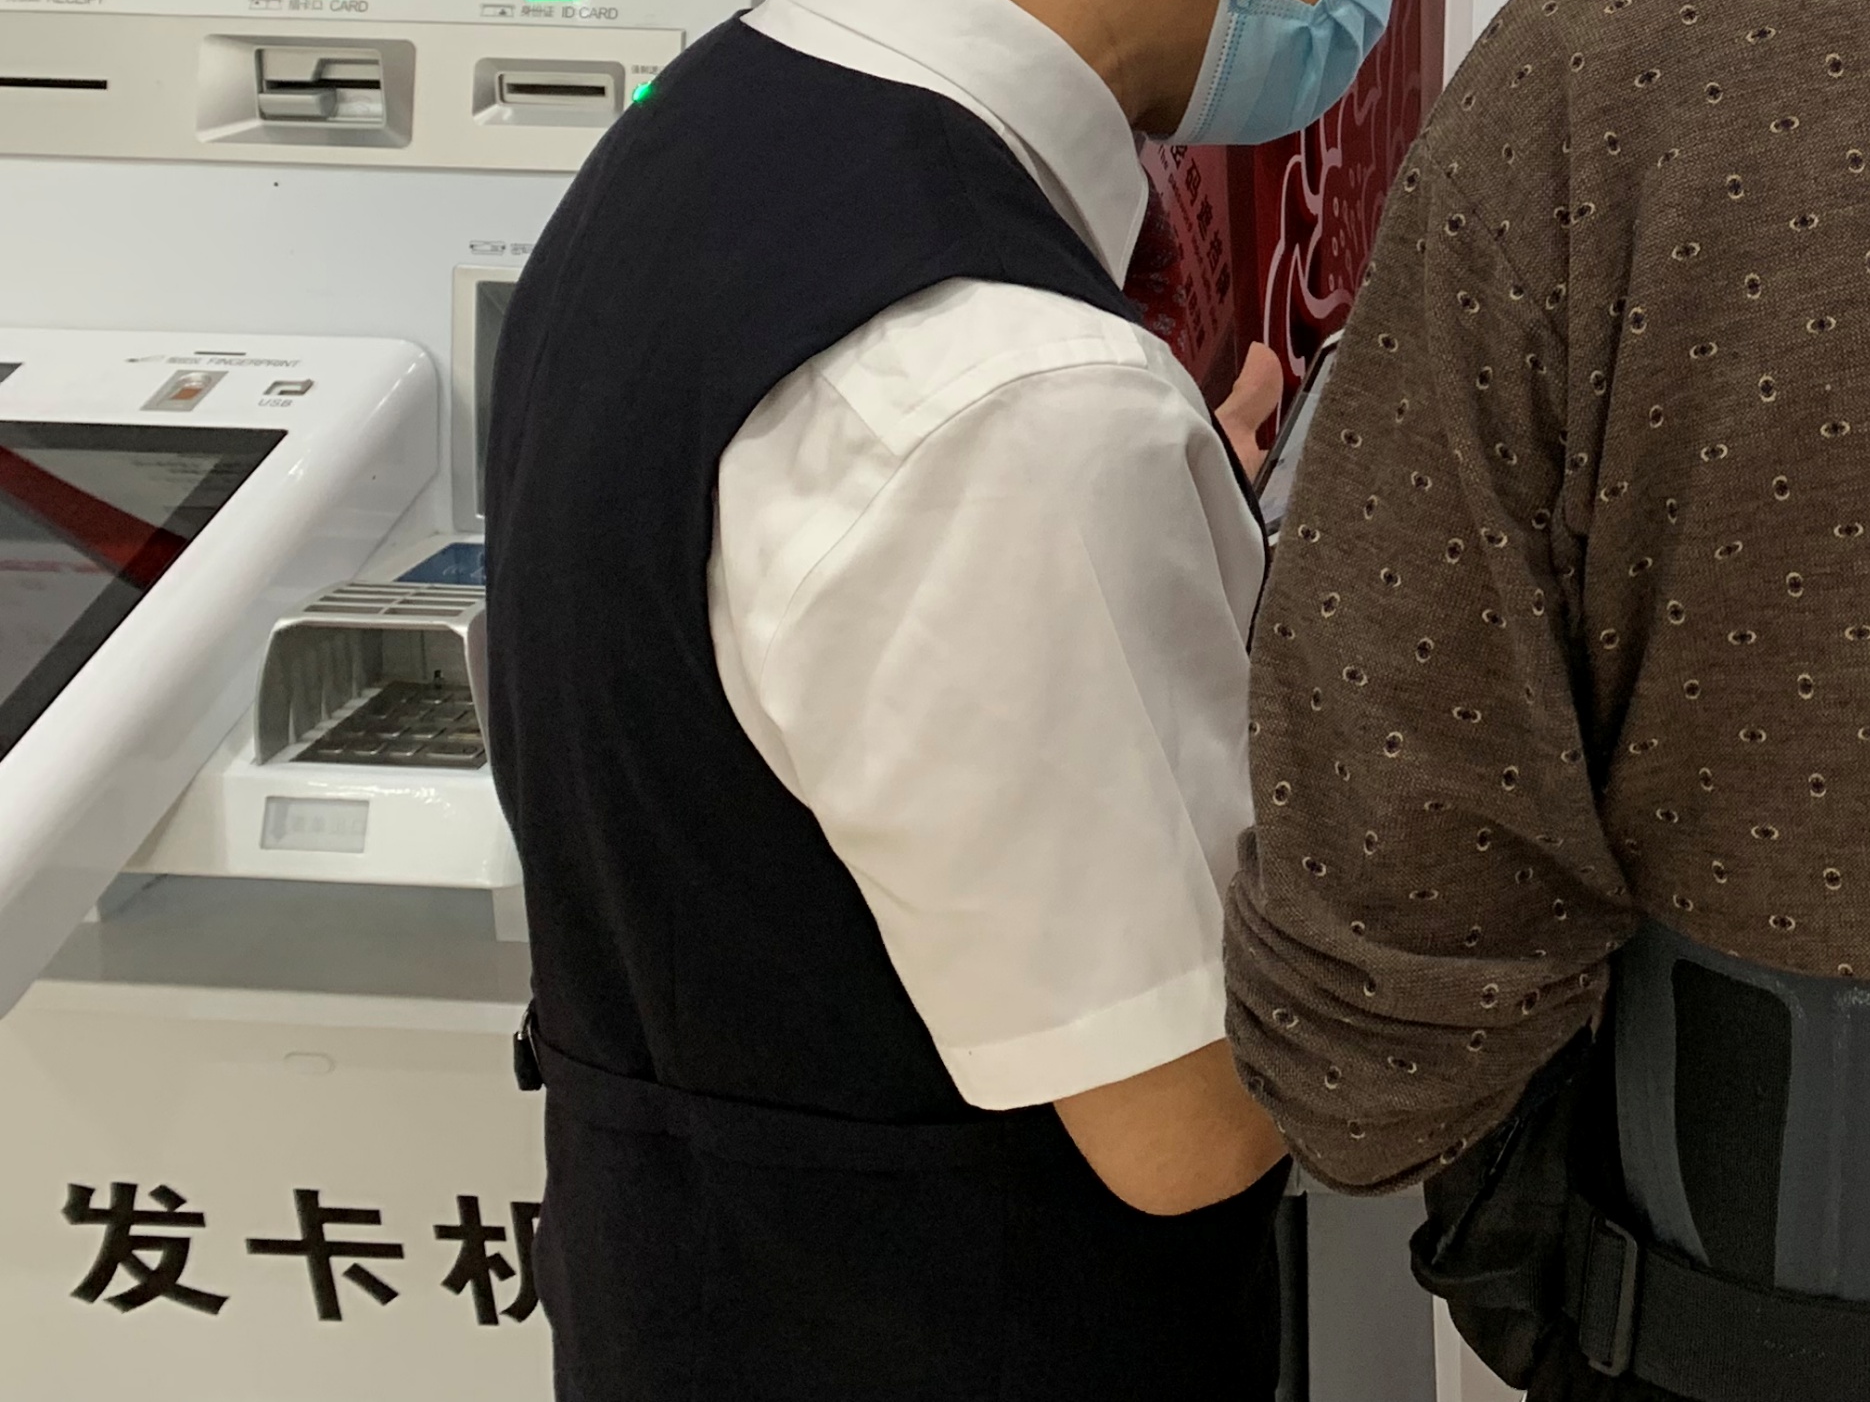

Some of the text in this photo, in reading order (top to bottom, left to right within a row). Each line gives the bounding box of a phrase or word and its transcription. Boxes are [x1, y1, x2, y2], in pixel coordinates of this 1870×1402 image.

[330, 0, 368, 13] CARD
[521, 6, 619, 20] 身份证 ID CARD
[206, 356, 301, 368] FINGERPRINT
[258, 398, 294, 408] USB
[62, 1181, 543, 1326] 发卡机
